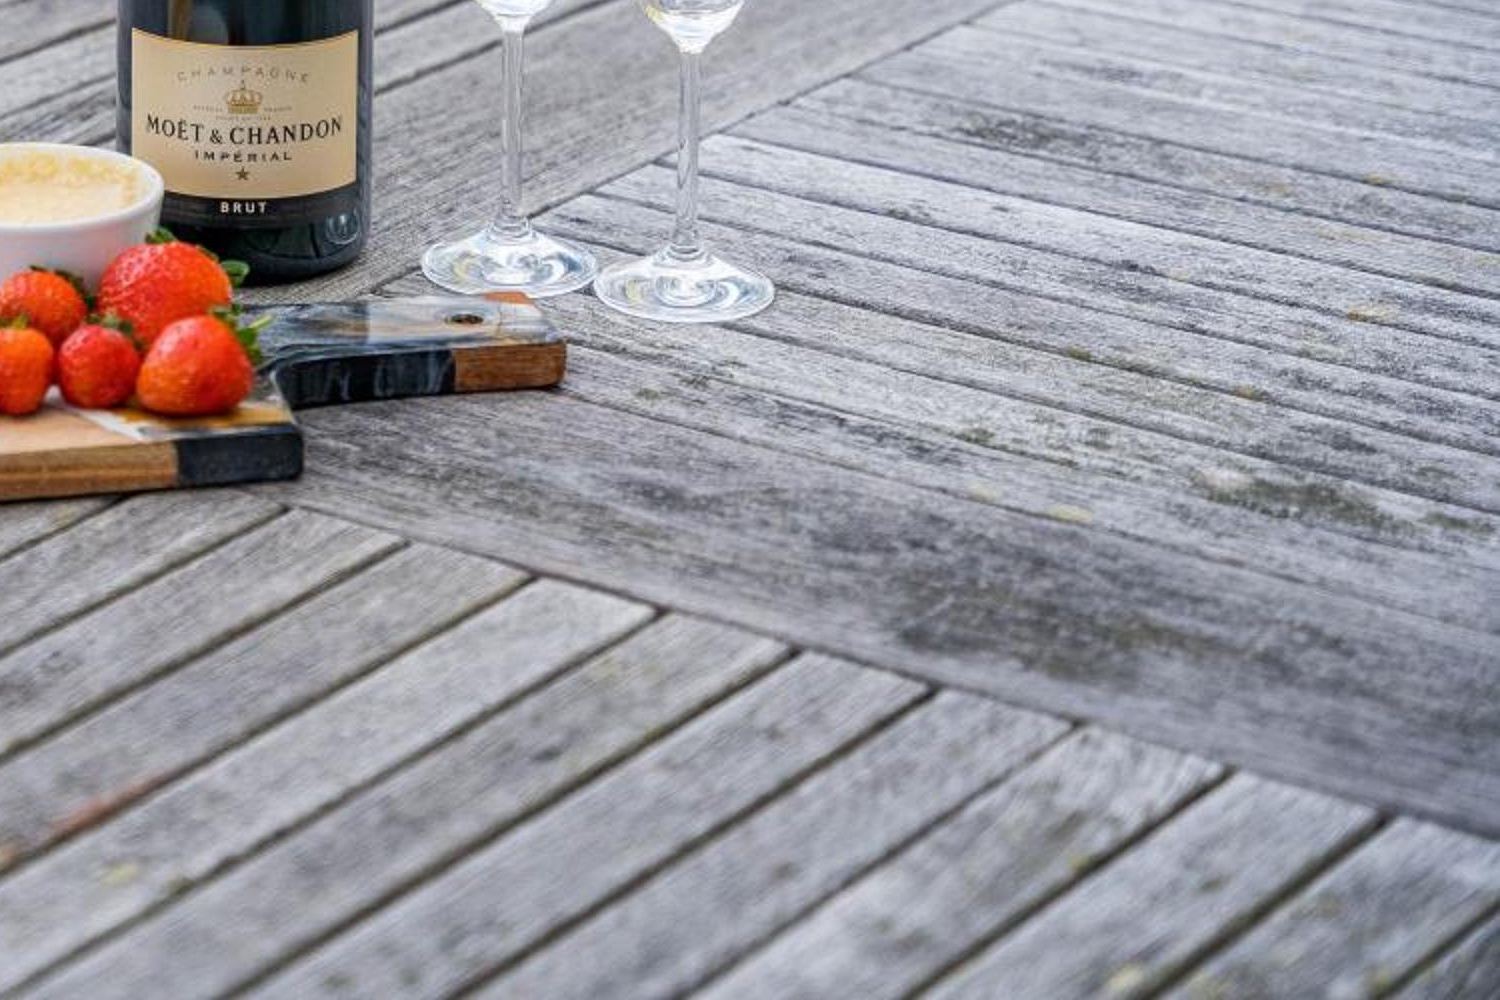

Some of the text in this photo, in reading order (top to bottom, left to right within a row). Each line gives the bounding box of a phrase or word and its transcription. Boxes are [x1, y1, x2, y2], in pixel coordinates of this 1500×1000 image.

[177, 66, 311, 83] CHAMPAGNE
[209, 129, 224, 145] &
[229, 116, 342, 145] CHANDON
[220, 201, 267, 214] BRUT
